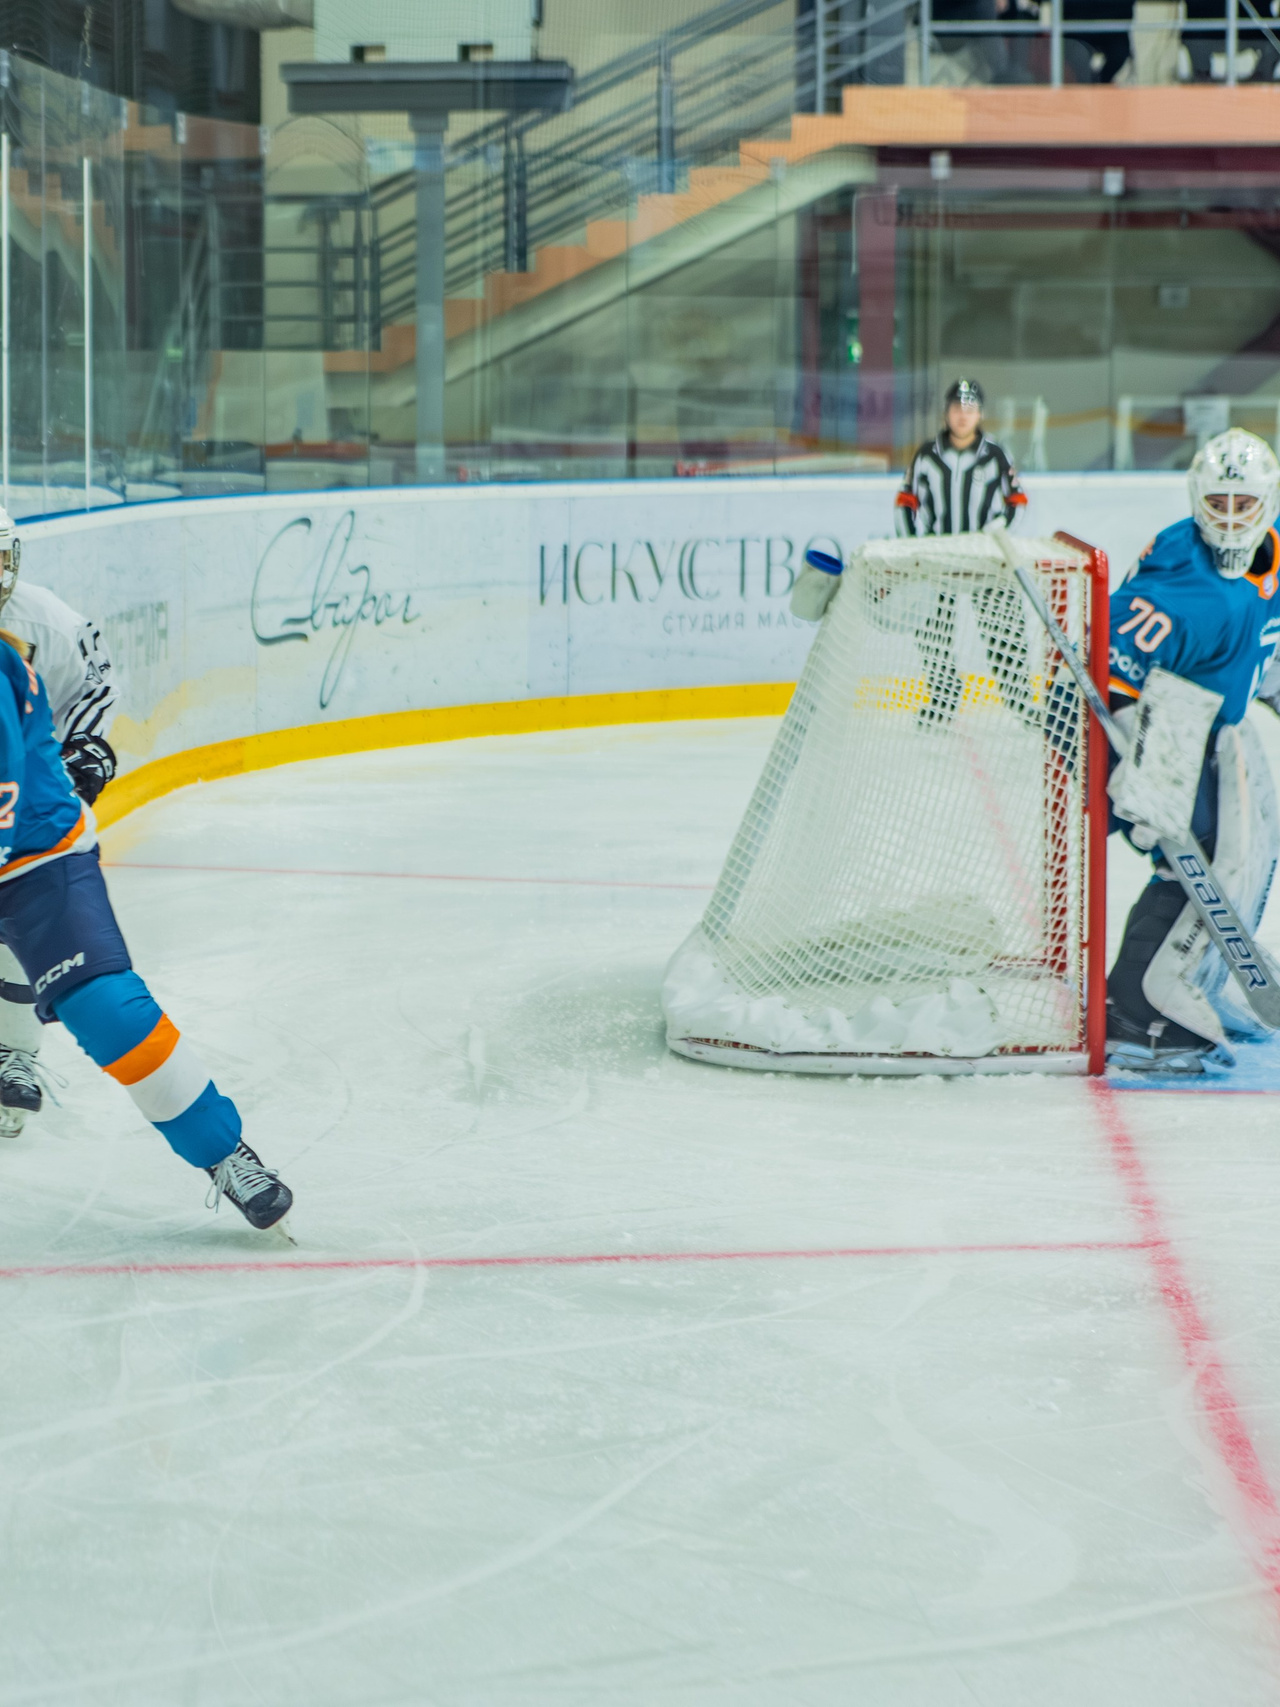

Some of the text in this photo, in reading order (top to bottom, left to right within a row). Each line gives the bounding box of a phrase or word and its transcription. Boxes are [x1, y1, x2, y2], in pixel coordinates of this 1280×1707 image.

[662, 610, 745, 635] СТУДИЯ
[1117, 596, 1173, 653] 70
[1175, 853, 1269, 992] BAUER
[34, 952, 85, 996] CCM
